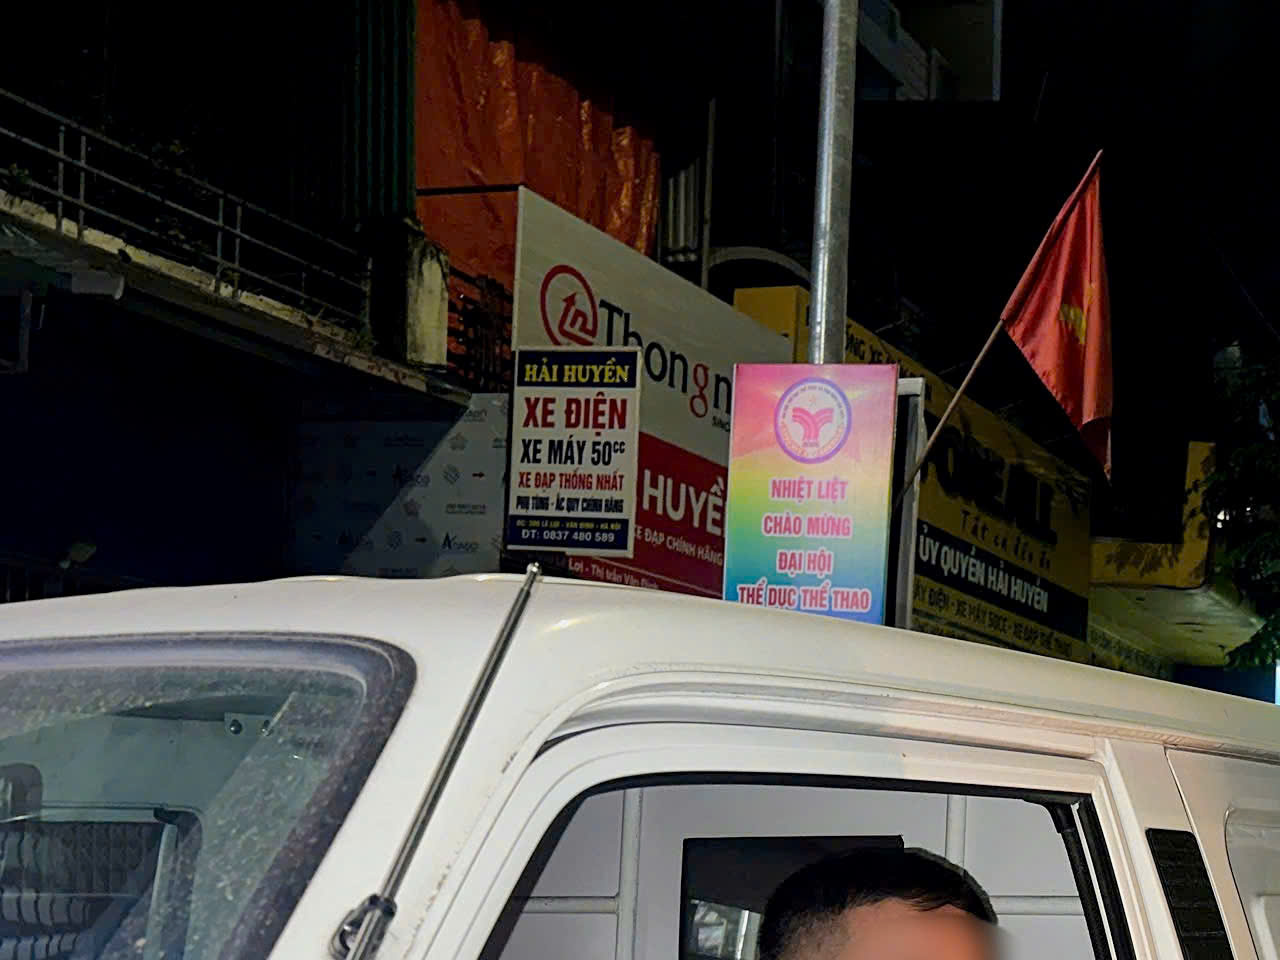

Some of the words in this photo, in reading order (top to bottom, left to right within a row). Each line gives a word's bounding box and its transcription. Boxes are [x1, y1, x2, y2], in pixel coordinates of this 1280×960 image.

[524, 357, 558, 382] HẢI
[523, 397, 556, 428] XE
[565, 391, 627, 436] ĐIỆN
[520, 439, 542, 464] XE
[547, 435, 586, 465] MÁY
[518, 472, 531, 488] XE
[534, 472, 555, 492] ĐẠP
[559, 467, 593, 490] THỐNG
[596, 468, 624, 491] NHẤT
[770, 476, 813, 503] NHIỆT
[817, 477, 848, 503] LIỆT
[543, 530, 569, 540] 0837
[572, 531, 592, 541] 480
[594, 532, 615, 542] 589
[763, 511, 802, 535] CHÀO
[807, 513, 850, 537] MỪNG
[777, 551, 802, 575] ĐẠI
[807, 549, 832, 577] HỘI
[738, 578, 766, 606] THỂ
[768, 586, 797, 608] DỤC
[802, 581, 830, 608] THỂ
[832, 590, 869, 610] THAO
